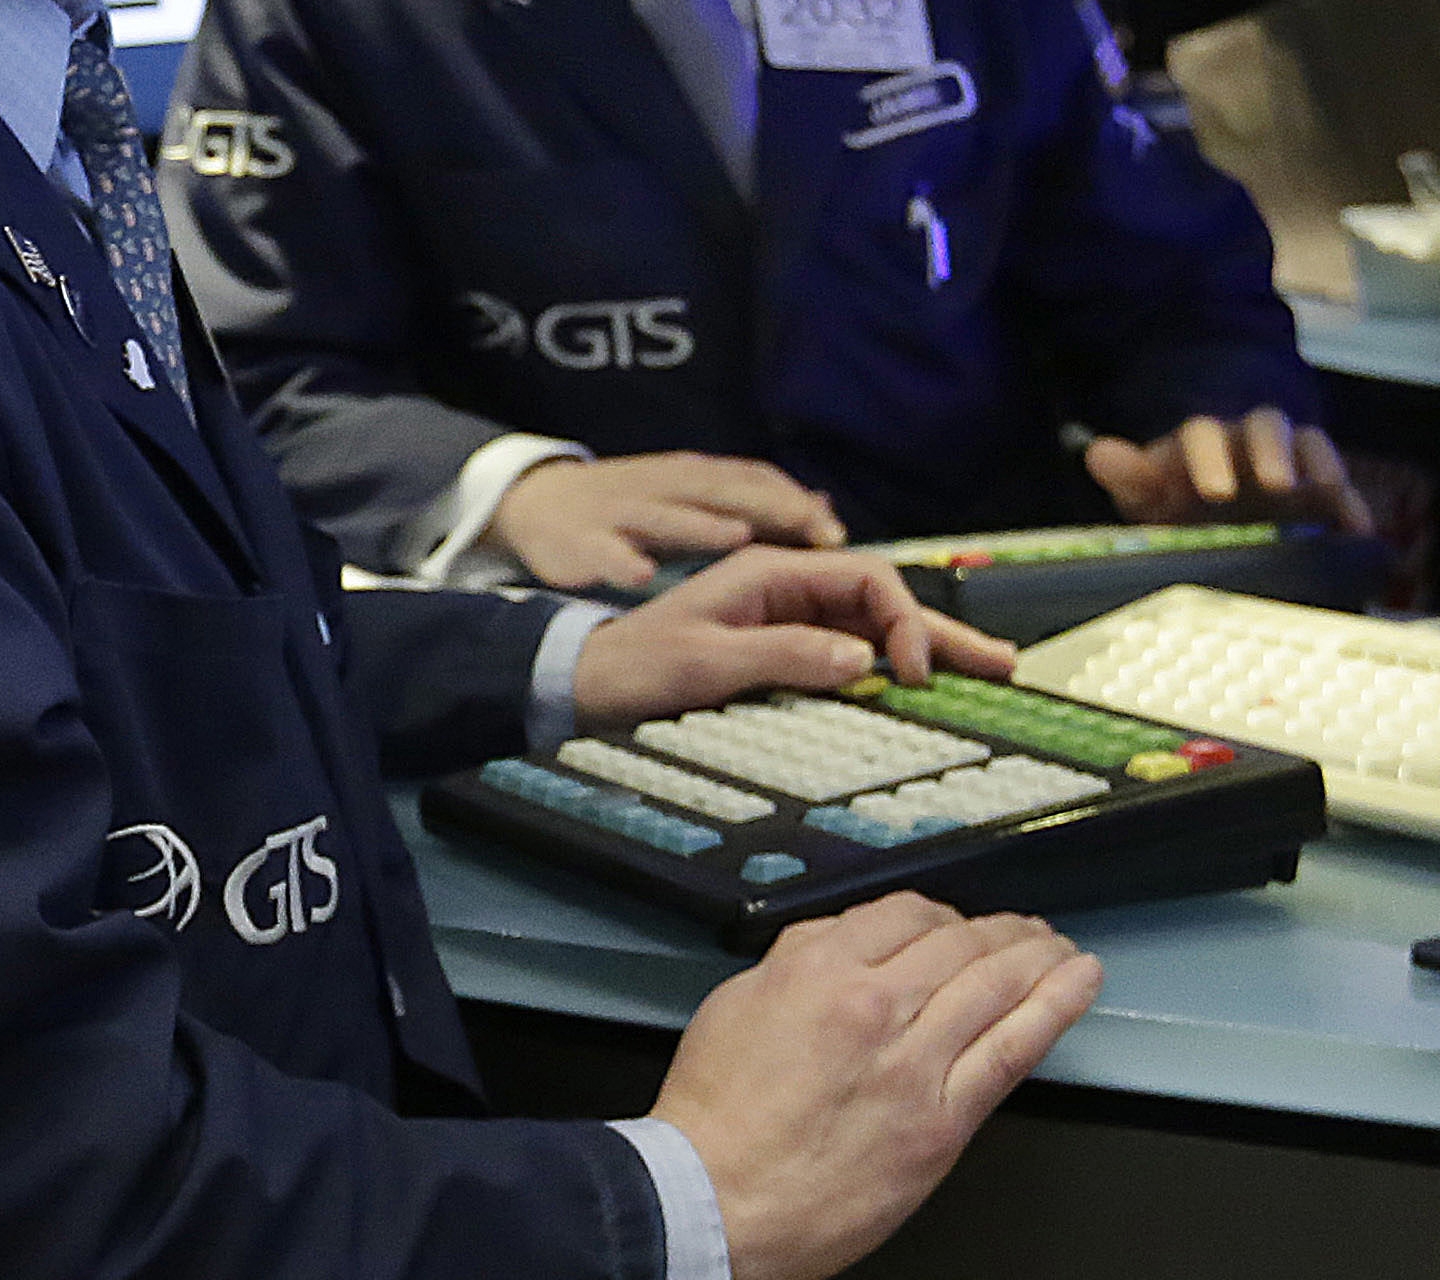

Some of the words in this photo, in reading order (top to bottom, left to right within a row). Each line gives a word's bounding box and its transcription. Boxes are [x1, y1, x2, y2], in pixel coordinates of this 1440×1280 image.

[188, 108, 296, 179] GTS
[533, 296, 695, 370] GTS
[222, 815, 339, 945] GTS
